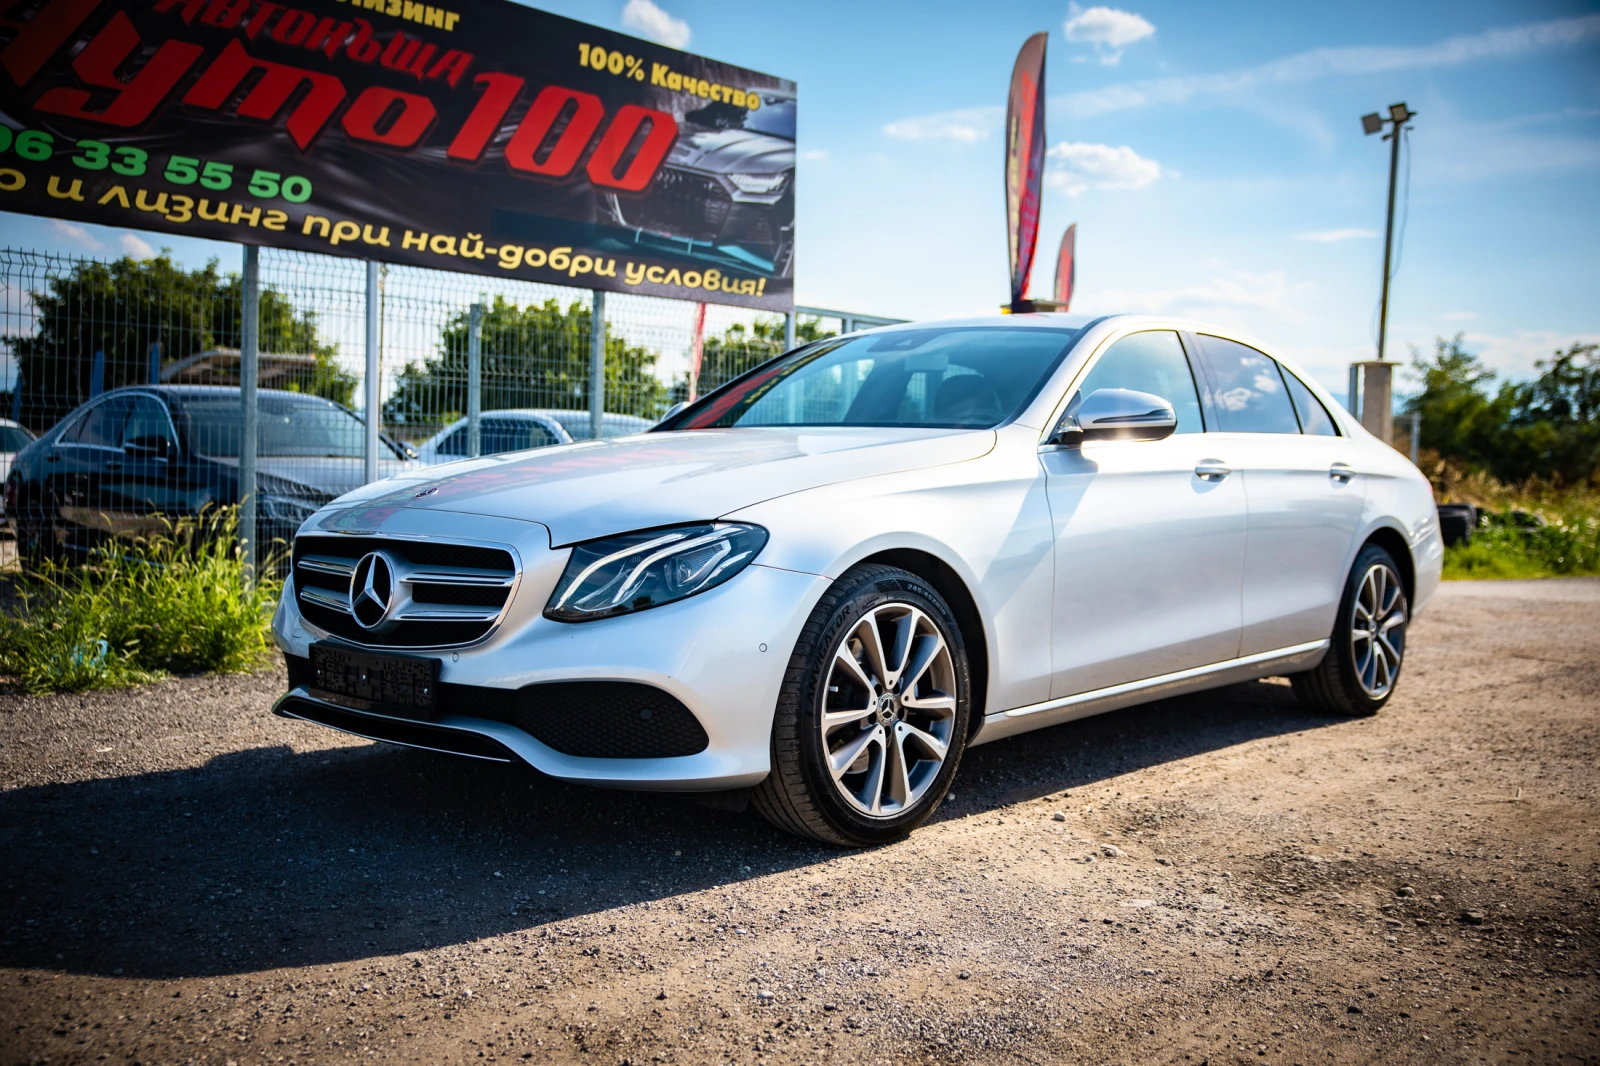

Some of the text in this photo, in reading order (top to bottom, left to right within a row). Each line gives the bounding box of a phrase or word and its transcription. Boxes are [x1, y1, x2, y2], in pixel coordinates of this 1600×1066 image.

[578, 42, 761, 111] 100% Качество
[0, 122, 313, 204] 6 33 55 50
[46, 174, 85, 202] и
[97, 185, 289, 231] лизинг
[302, 214, 391, 247] при
[401, 229, 617, 278] най-добри
[624, 261, 767, 298] условия!
[805, 603, 852, 717] LANVIGATOR
